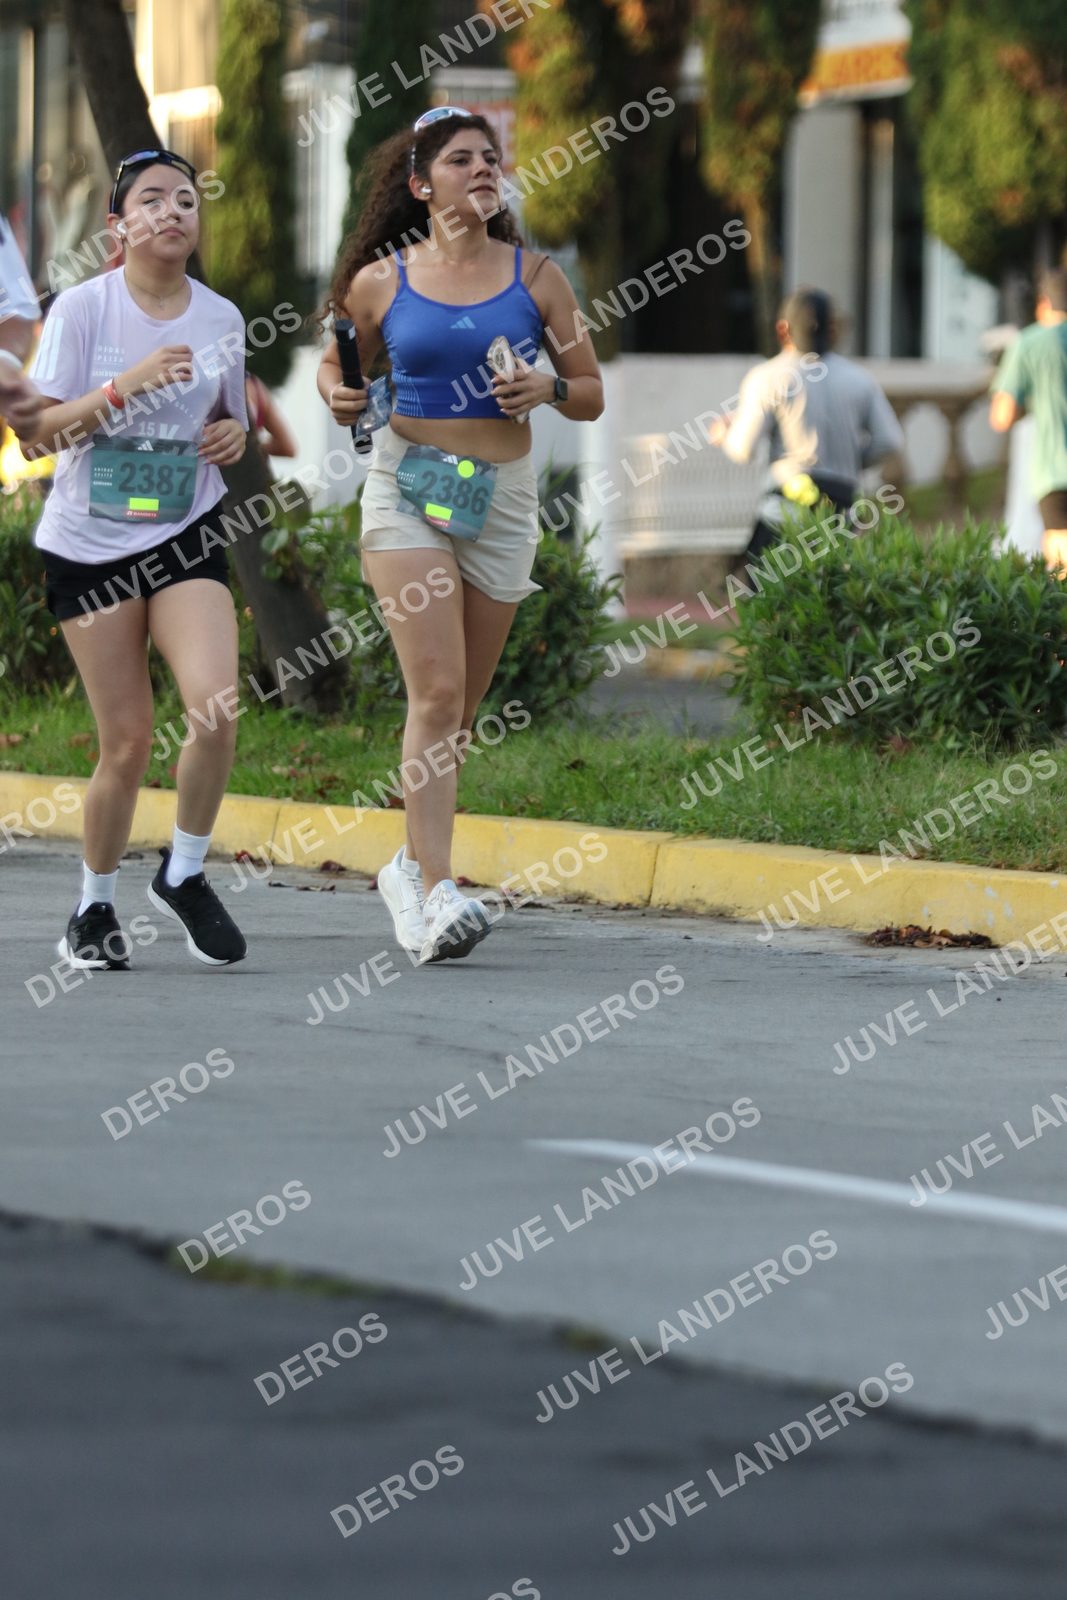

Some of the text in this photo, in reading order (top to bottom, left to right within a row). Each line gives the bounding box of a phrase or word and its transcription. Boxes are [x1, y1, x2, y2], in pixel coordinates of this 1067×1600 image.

[138, 421, 155, 437] 15
[117, 462, 193, 496] 2387
[416, 470, 489, 515] 2386
